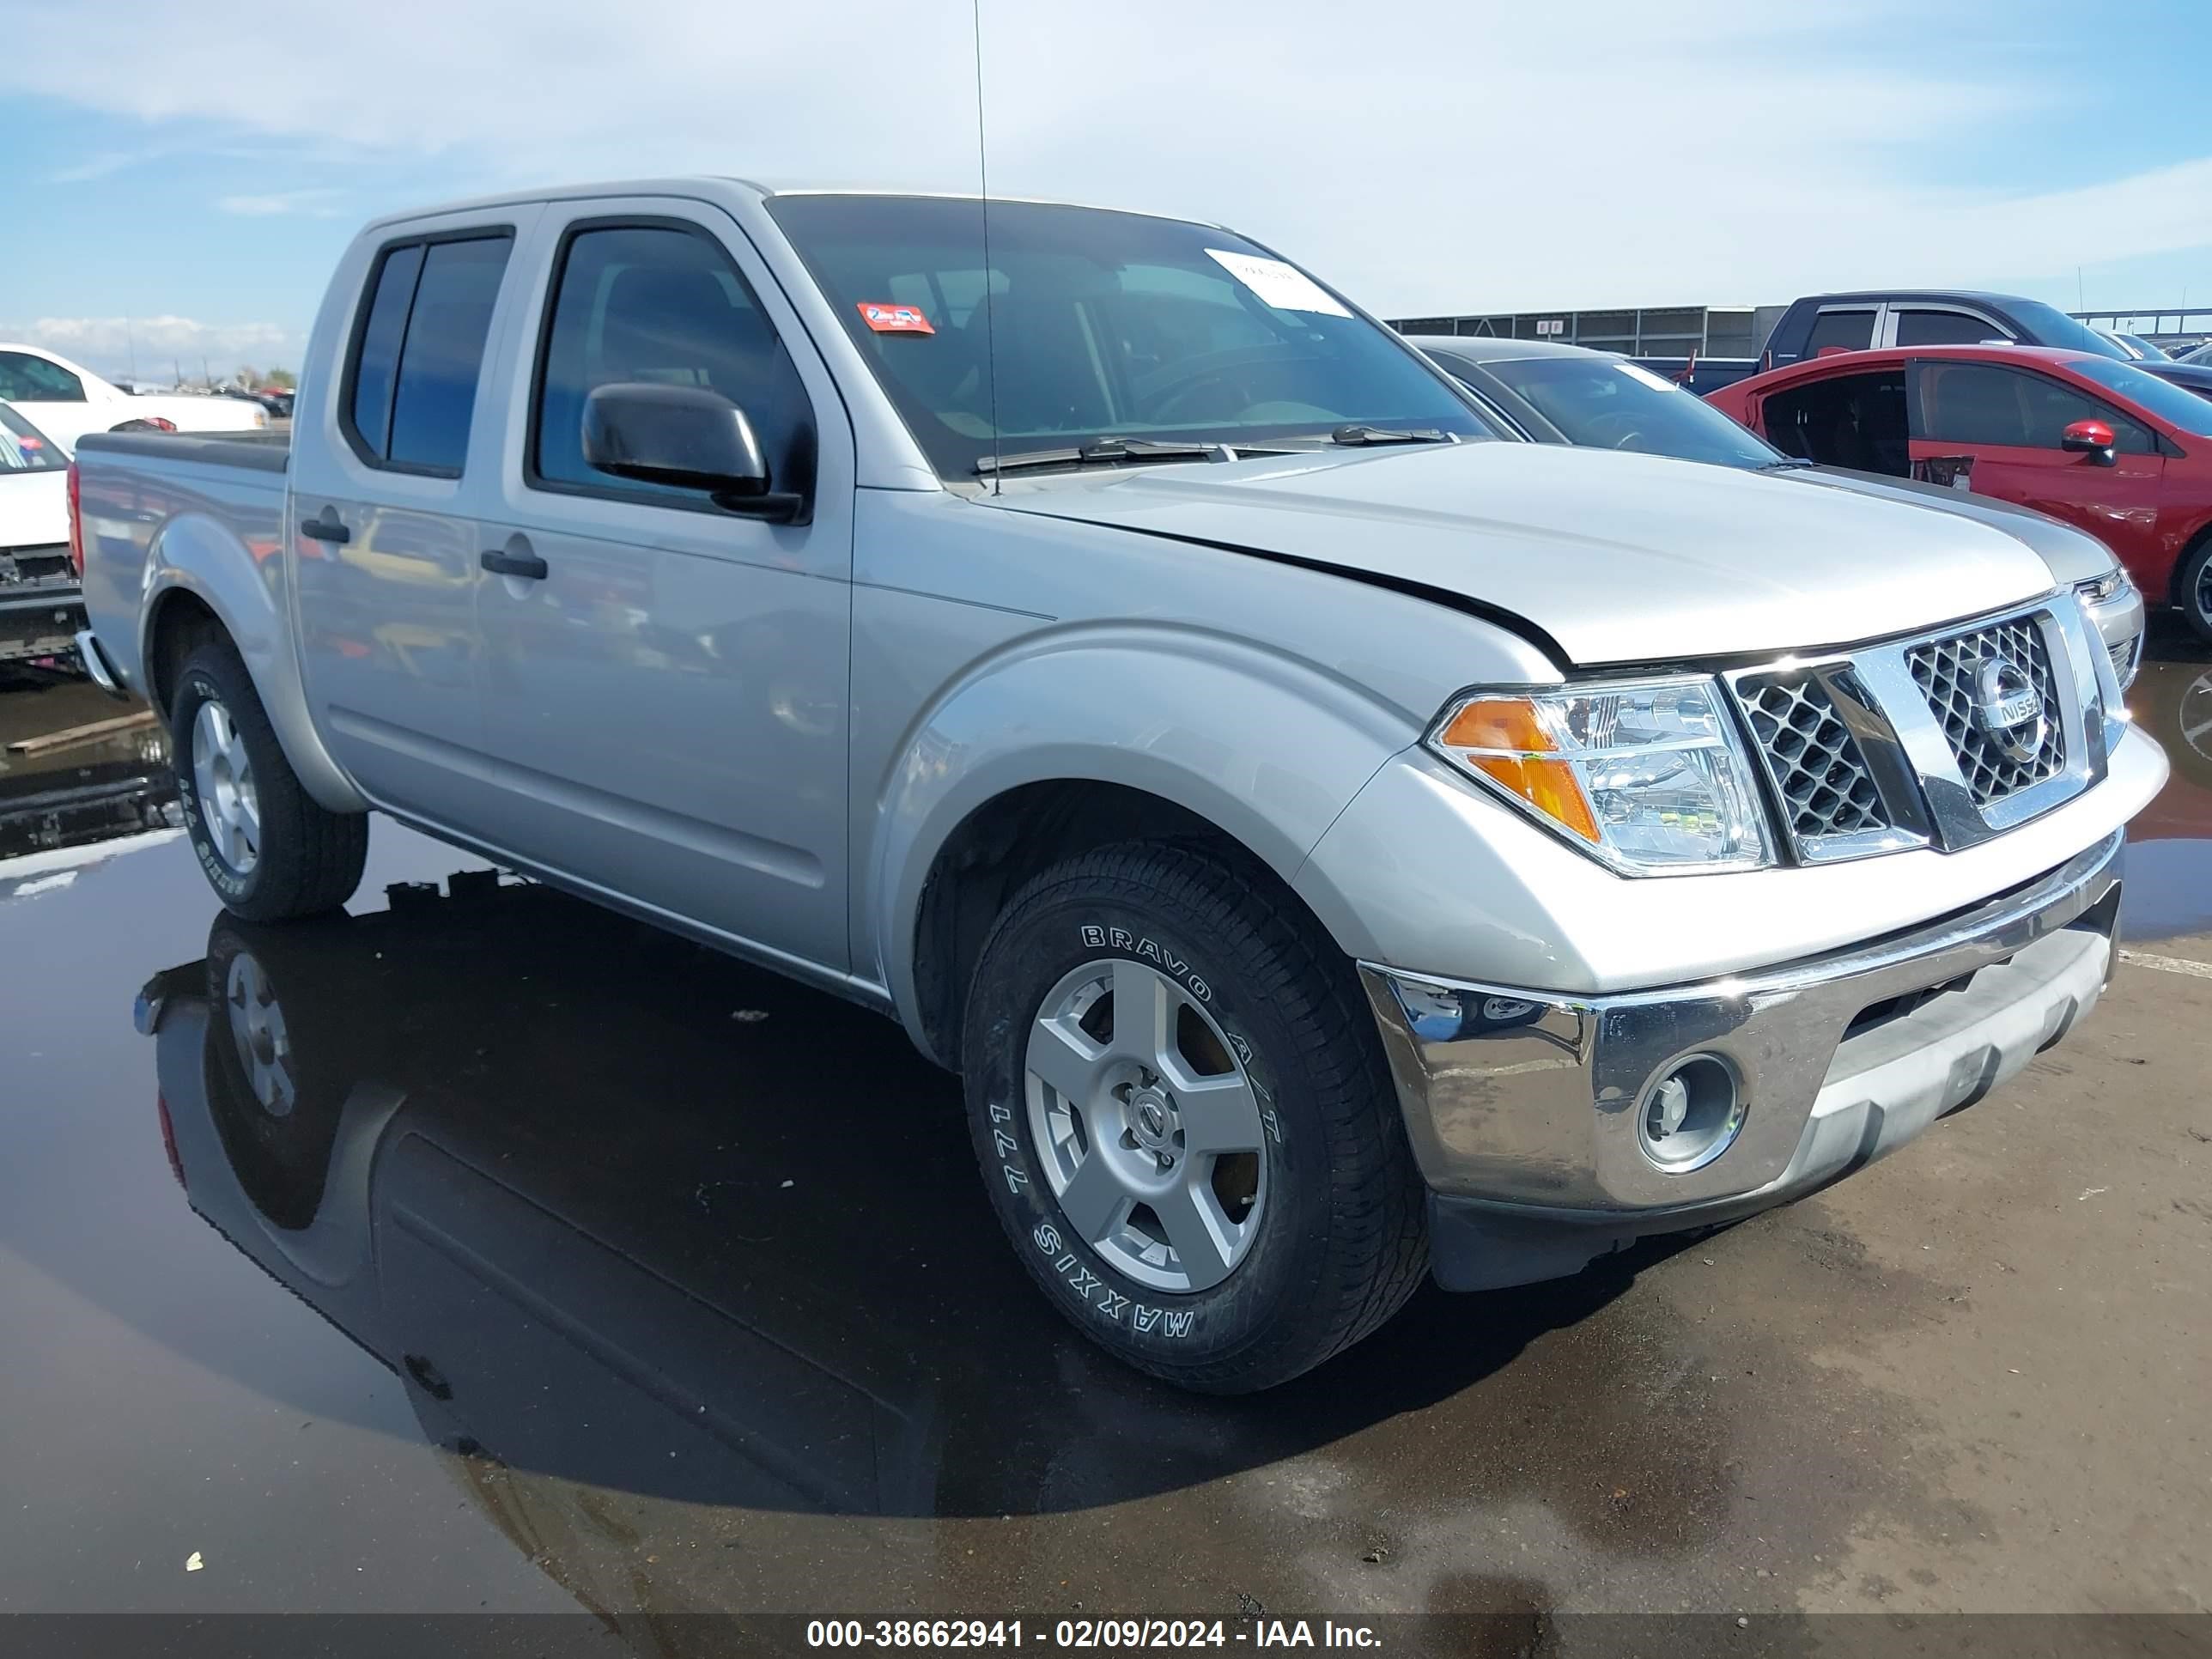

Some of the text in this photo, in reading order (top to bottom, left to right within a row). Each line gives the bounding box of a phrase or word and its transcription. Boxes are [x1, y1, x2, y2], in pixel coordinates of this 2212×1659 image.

[1081, 924, 1212, 1002] BRAVO
[989, 1103, 1195, 1339] MAXXIS 771
